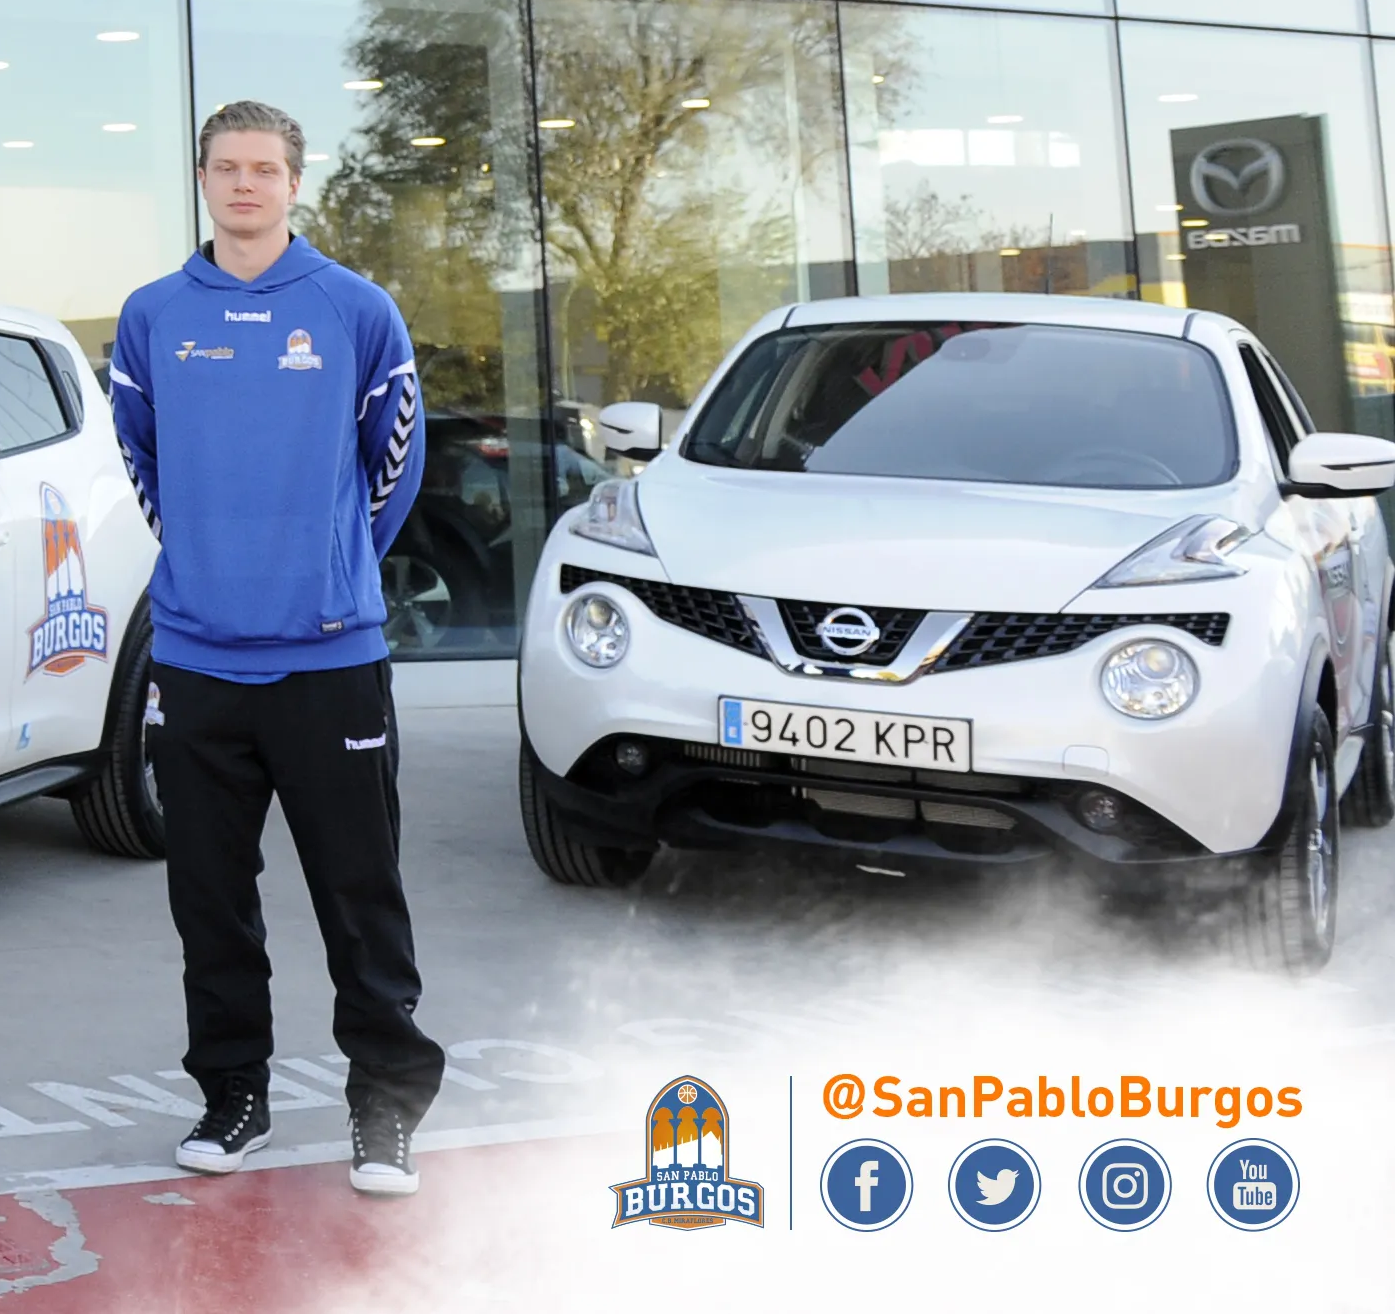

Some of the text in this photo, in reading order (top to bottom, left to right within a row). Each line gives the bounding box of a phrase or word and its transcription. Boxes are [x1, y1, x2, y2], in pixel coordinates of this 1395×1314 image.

[224, 309, 272, 324] hummel
[822, 625, 871, 637] NISSAN
[31, 612, 106, 669] BURGOS
[344, 733, 387, 751] hummel
[751, 709, 956, 763] 9402 KPR
